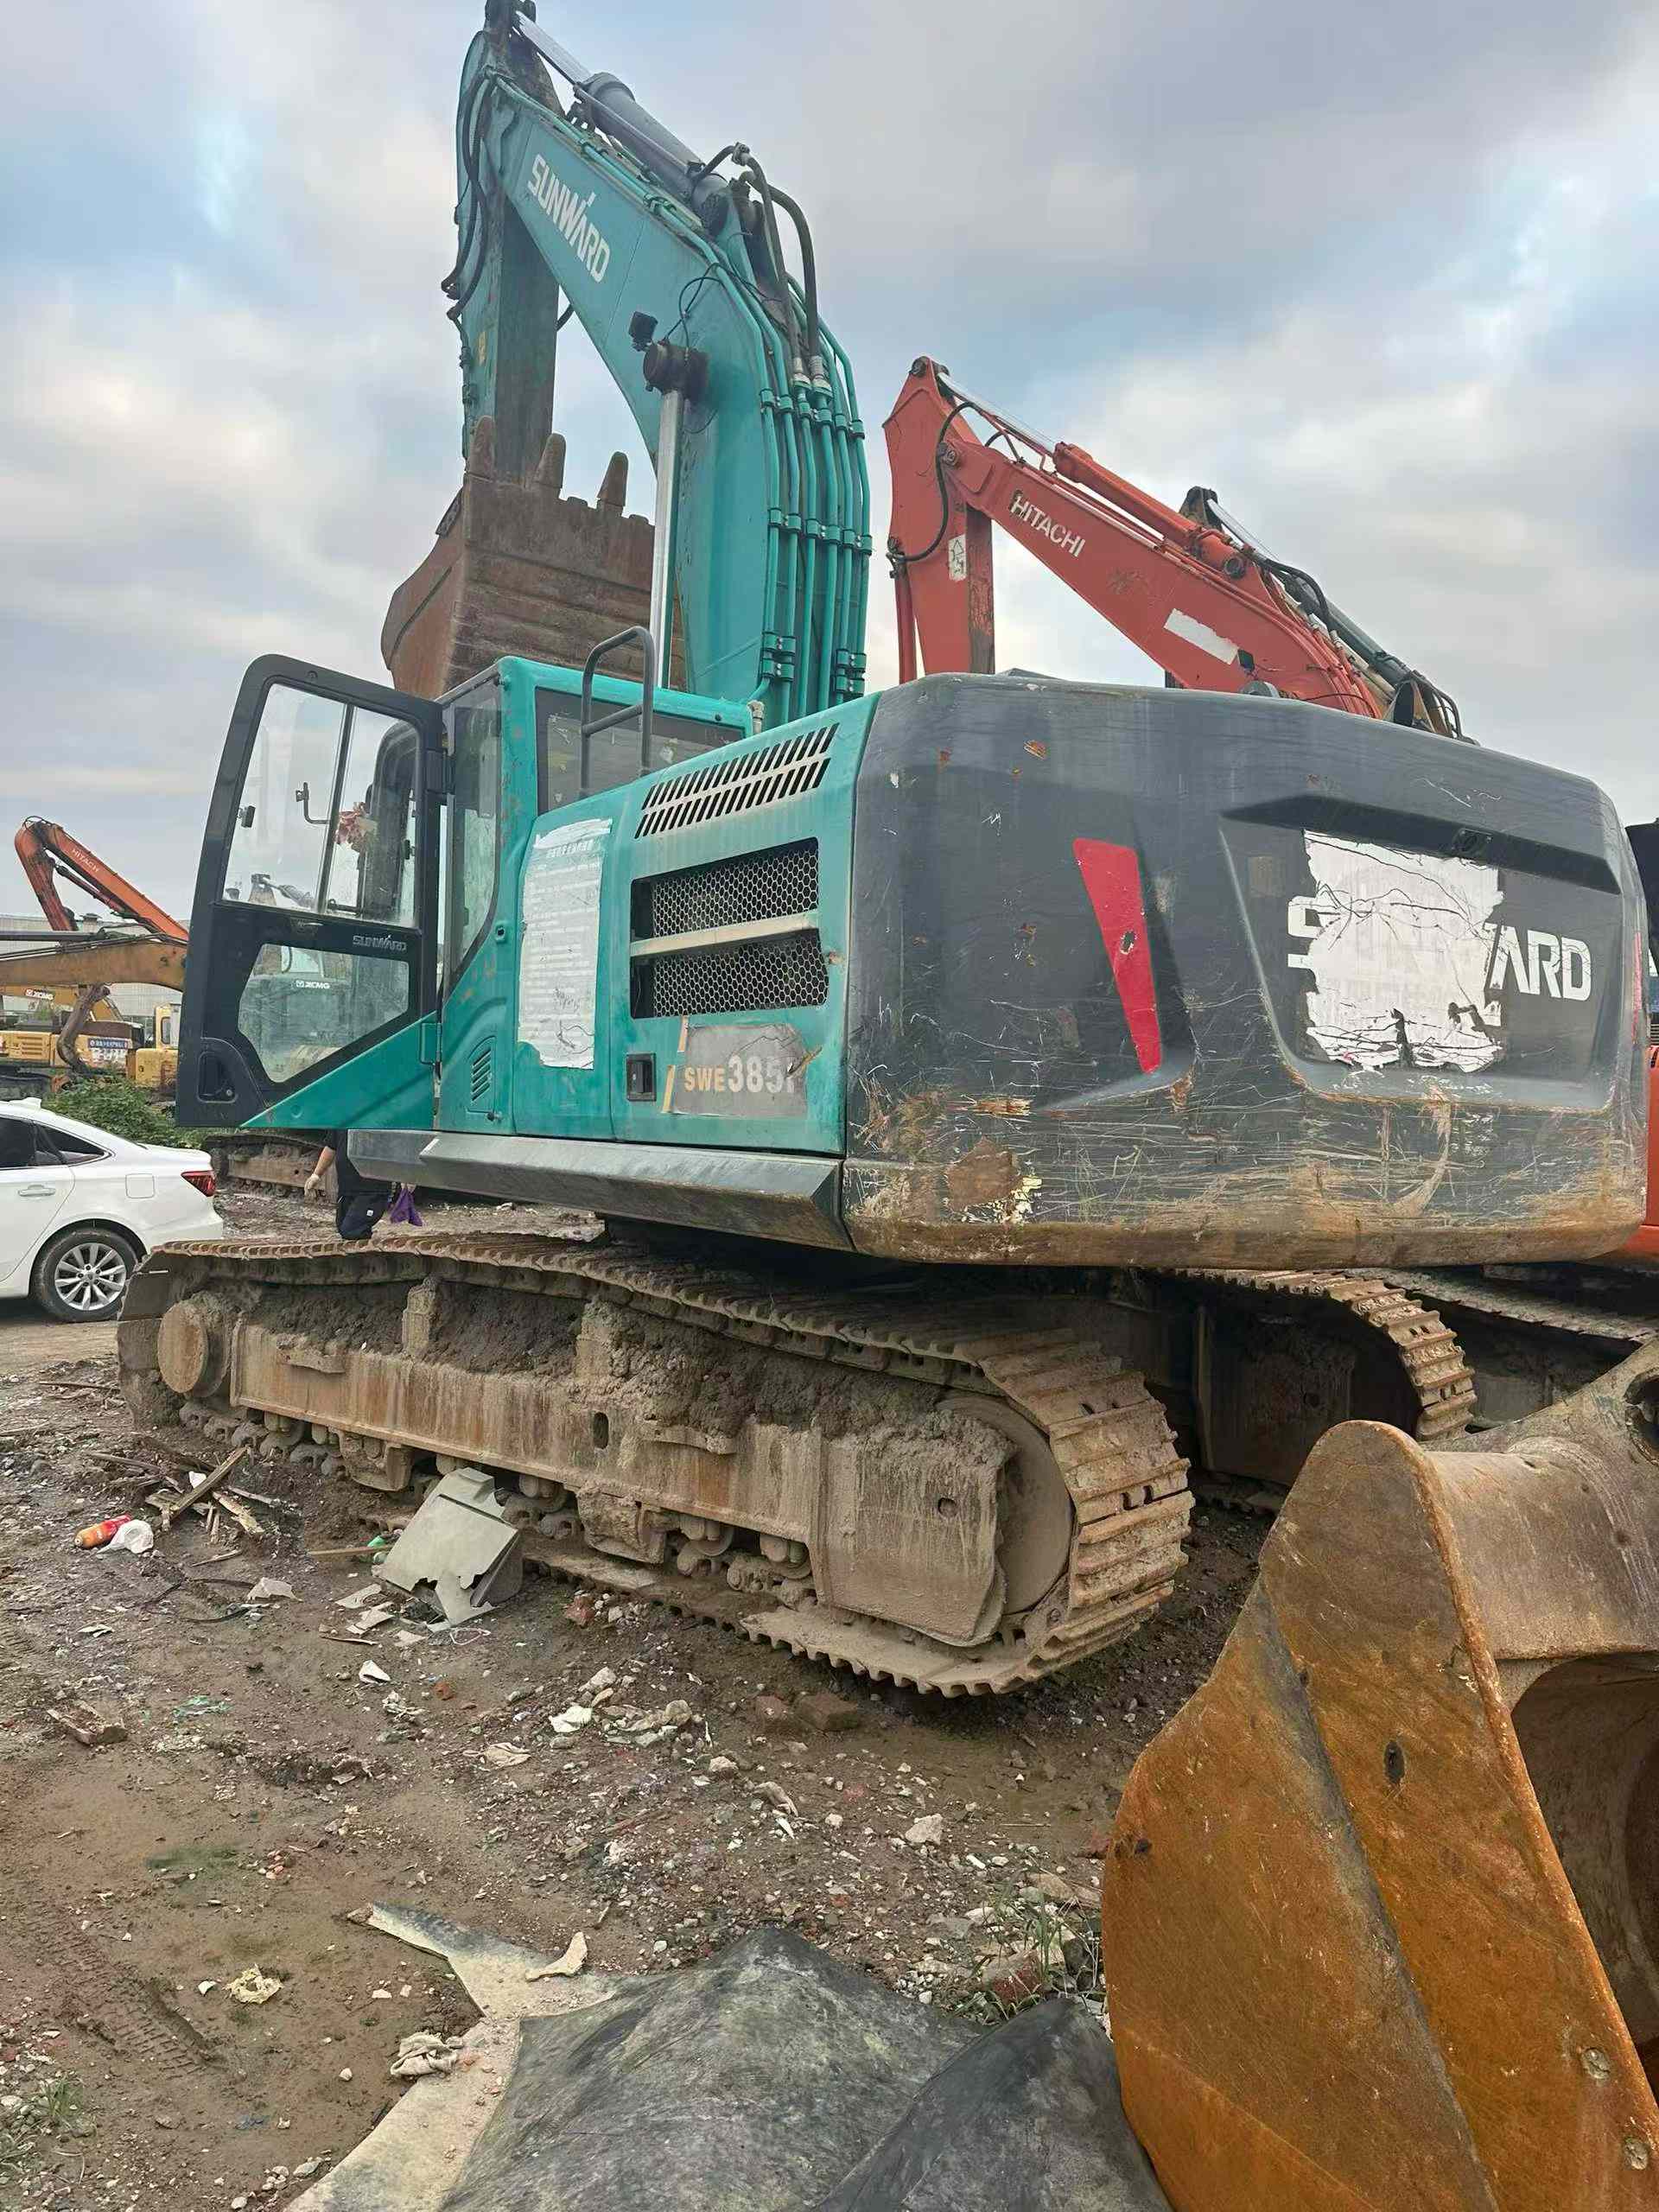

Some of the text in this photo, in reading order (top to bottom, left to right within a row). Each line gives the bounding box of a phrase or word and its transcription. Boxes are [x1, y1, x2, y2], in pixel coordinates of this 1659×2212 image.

[527, 154, 610, 283] SUNWARD
[1011, 496, 1086, 557] HITACHI
[353, 934, 407, 951] SUNWARD
